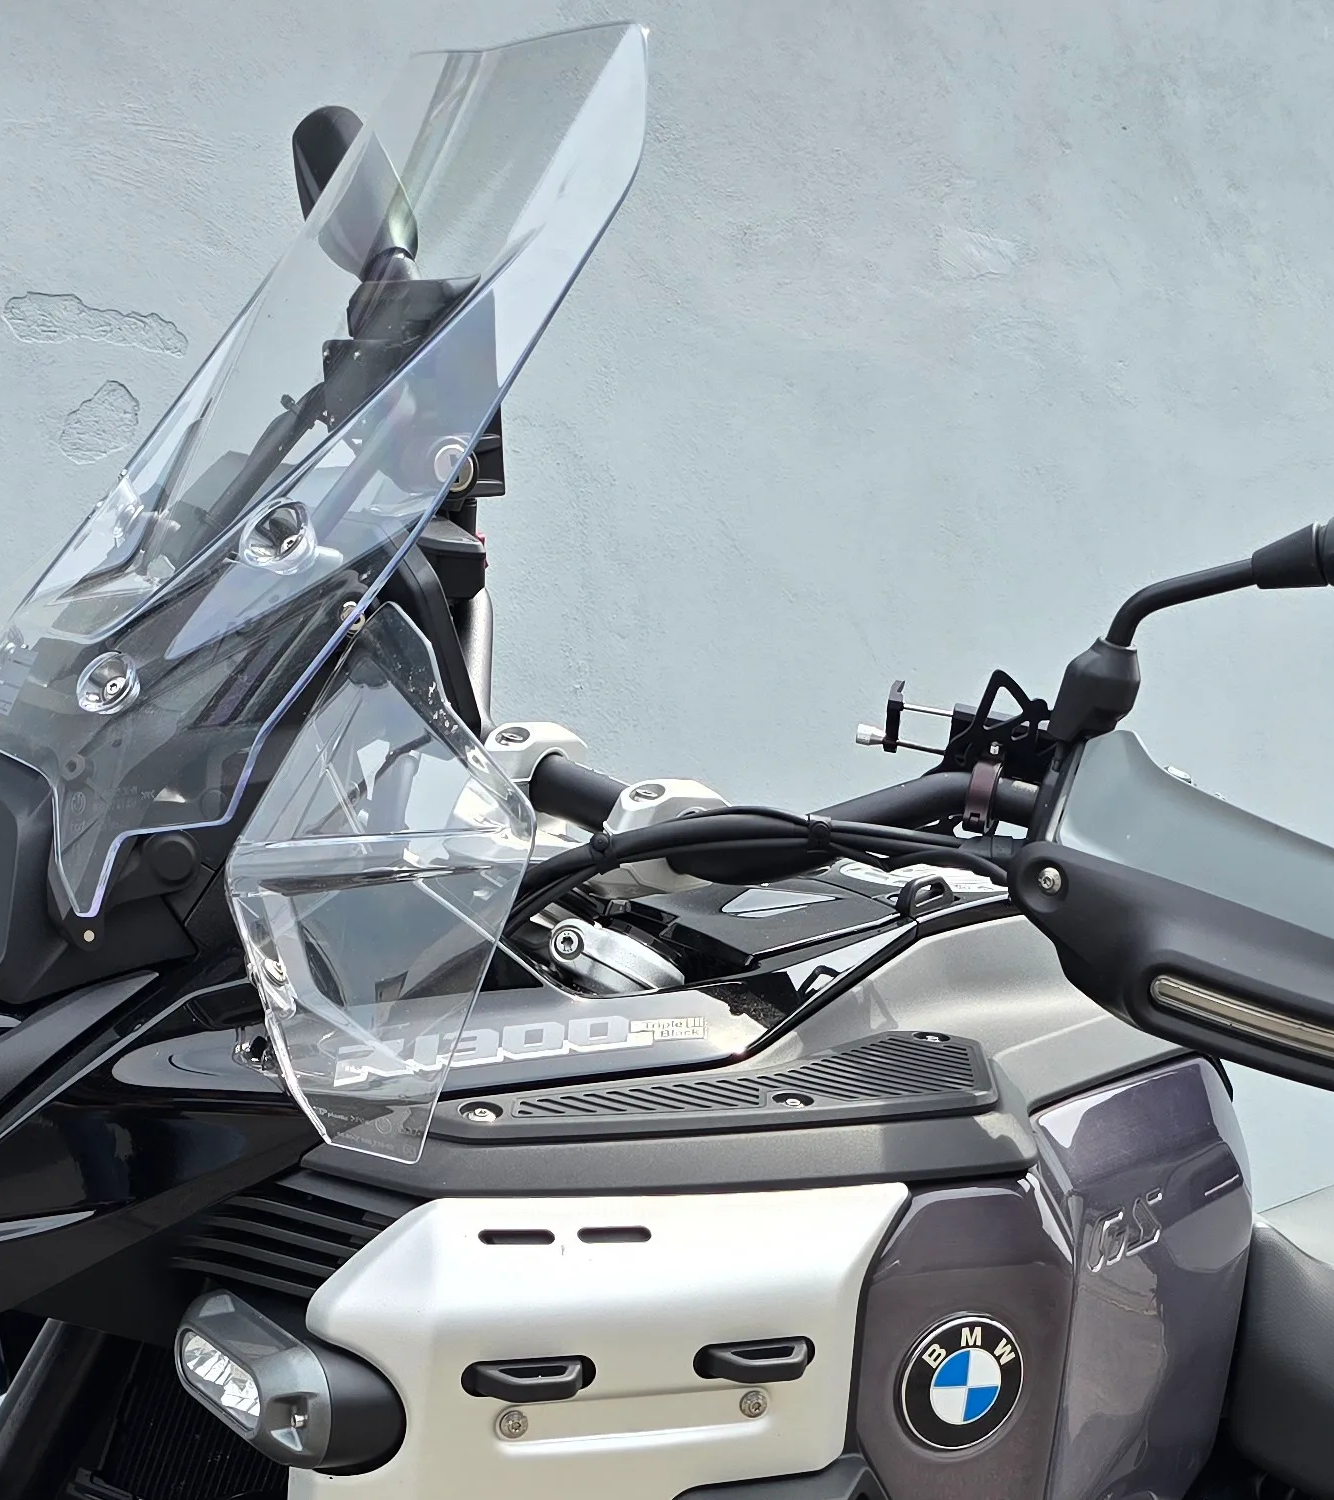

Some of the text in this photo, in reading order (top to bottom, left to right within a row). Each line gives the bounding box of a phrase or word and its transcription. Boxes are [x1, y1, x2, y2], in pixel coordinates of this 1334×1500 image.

[641, 1020, 683, 1030] Triple
[661, 1028, 700, 1038] Black
[1087, 1187, 1164, 1273] GS
[921, 1326, 1017, 1370] BMW
